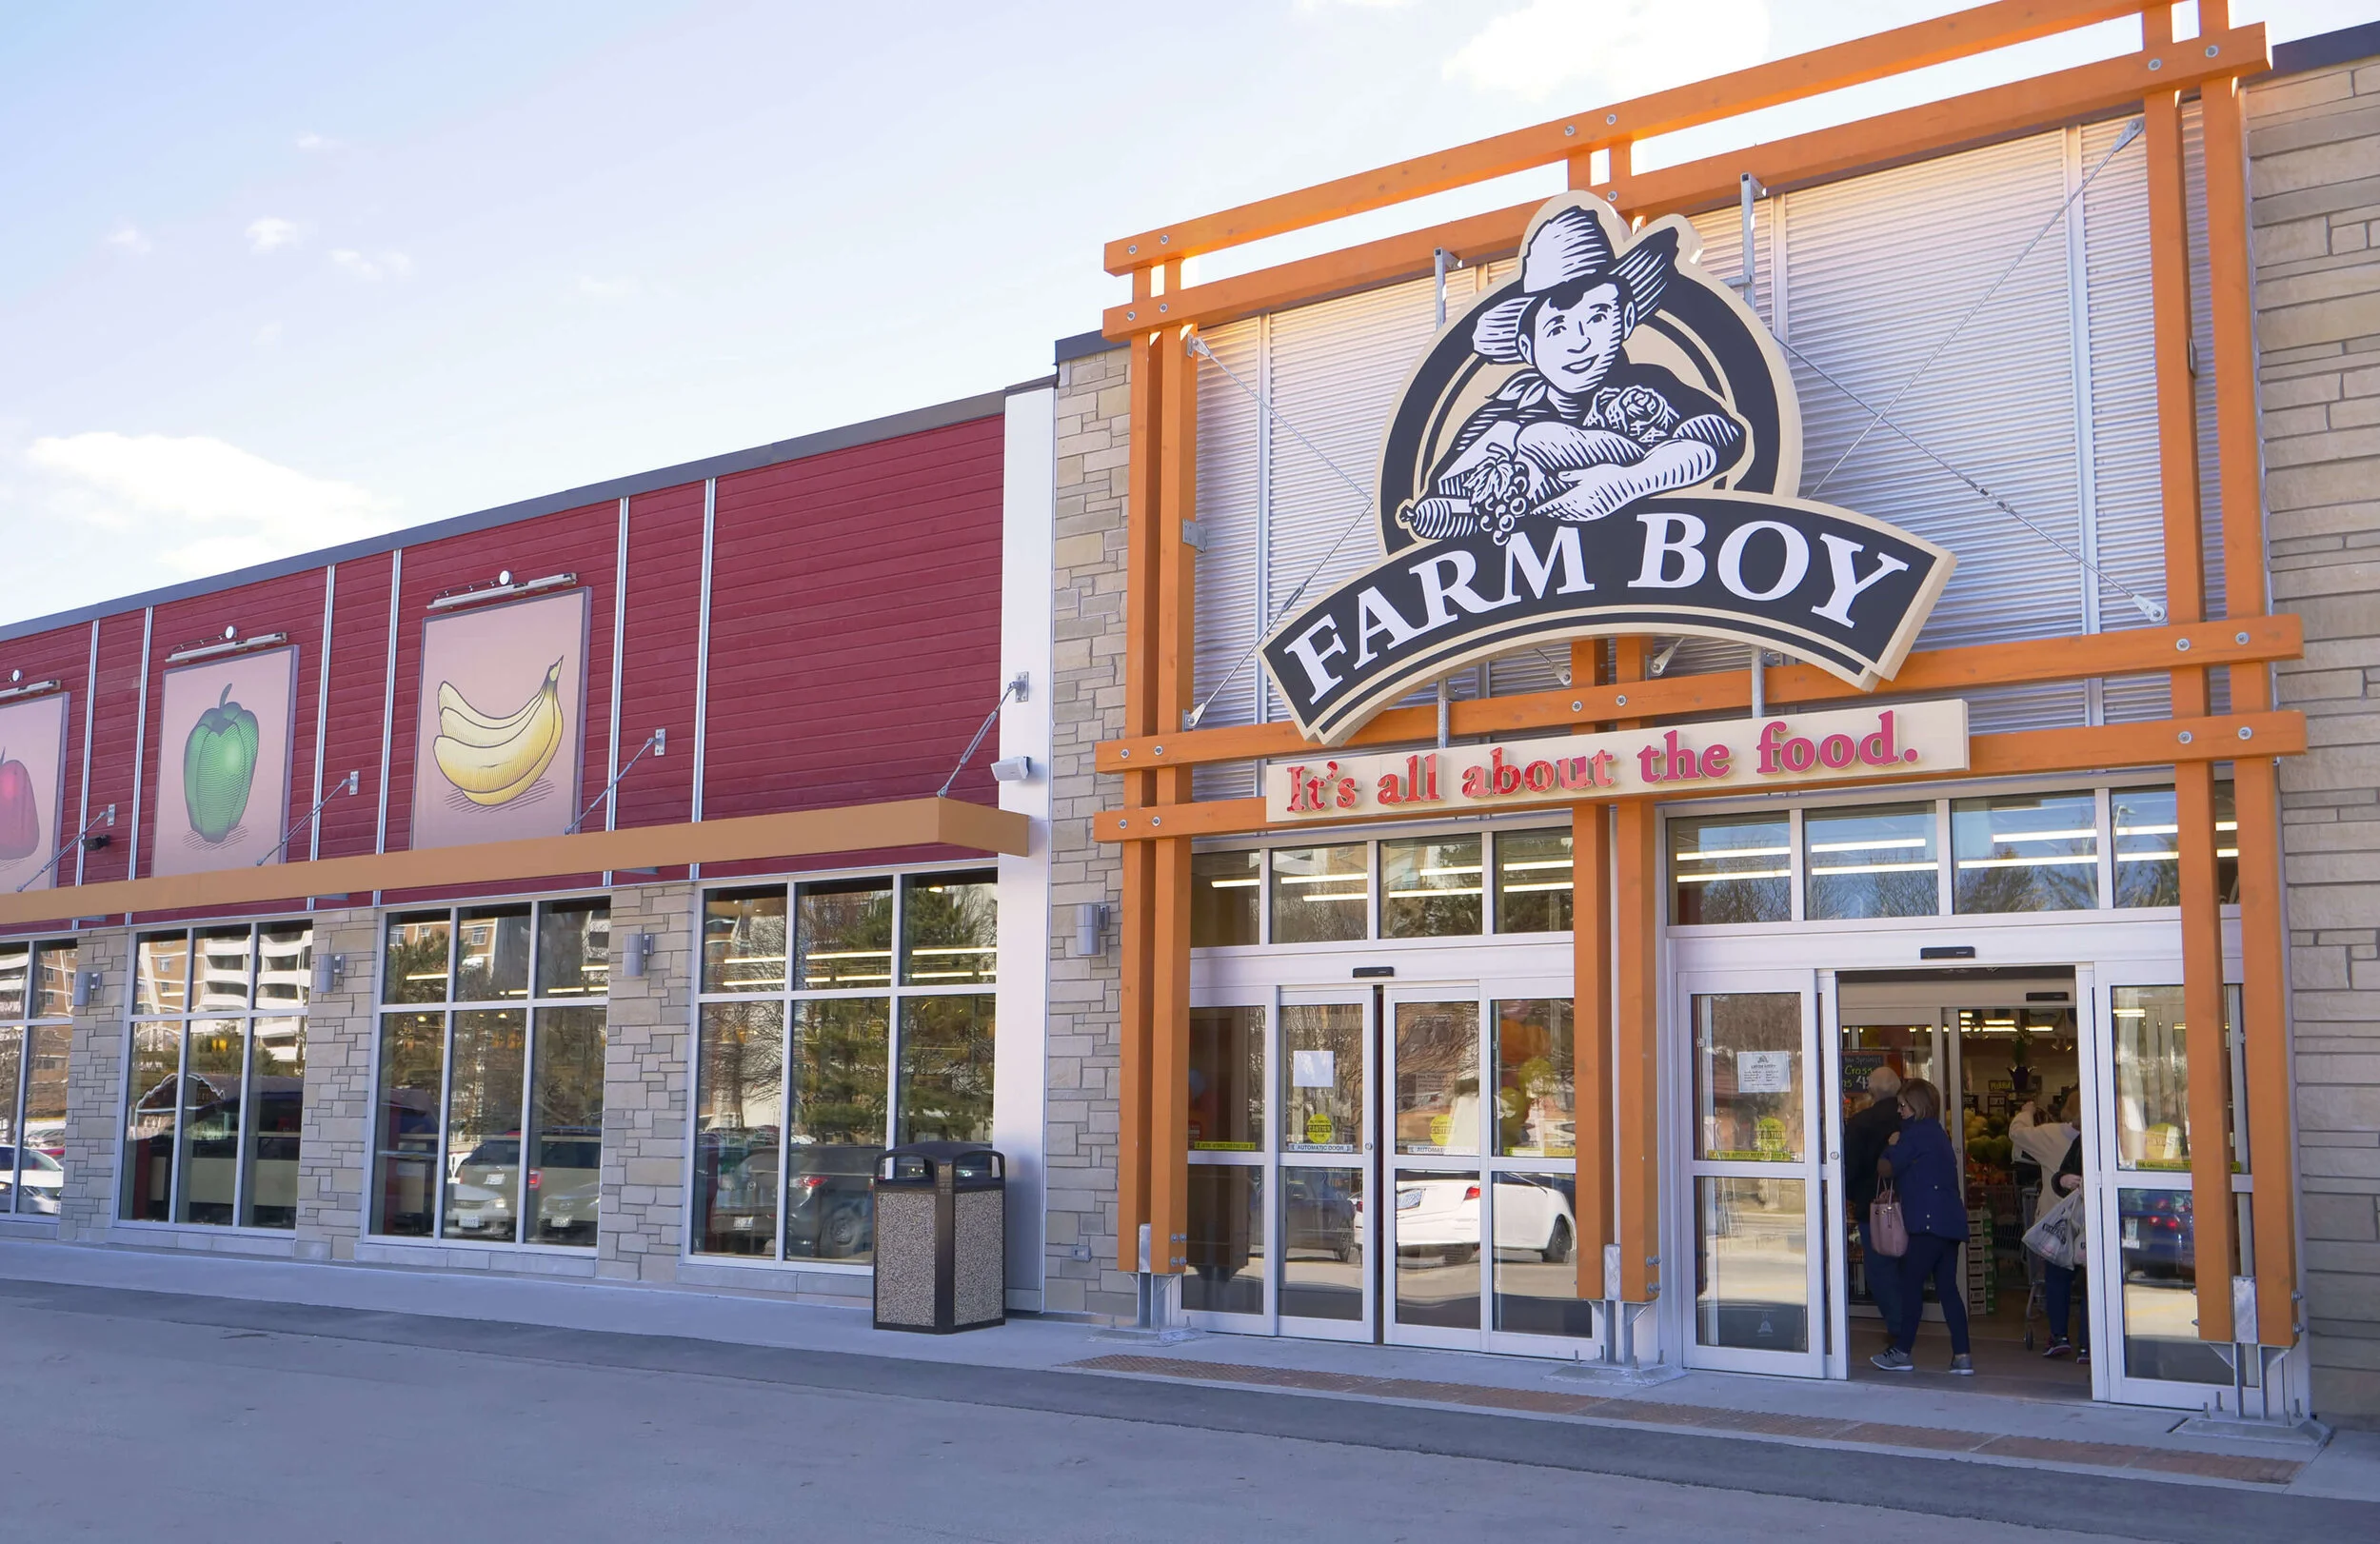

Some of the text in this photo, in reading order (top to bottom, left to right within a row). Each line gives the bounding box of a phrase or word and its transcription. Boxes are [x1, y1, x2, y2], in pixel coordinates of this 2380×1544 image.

[1283, 512, 1909, 705] FARM BOY
[1285, 709, 1919, 813] It's all about the food.
